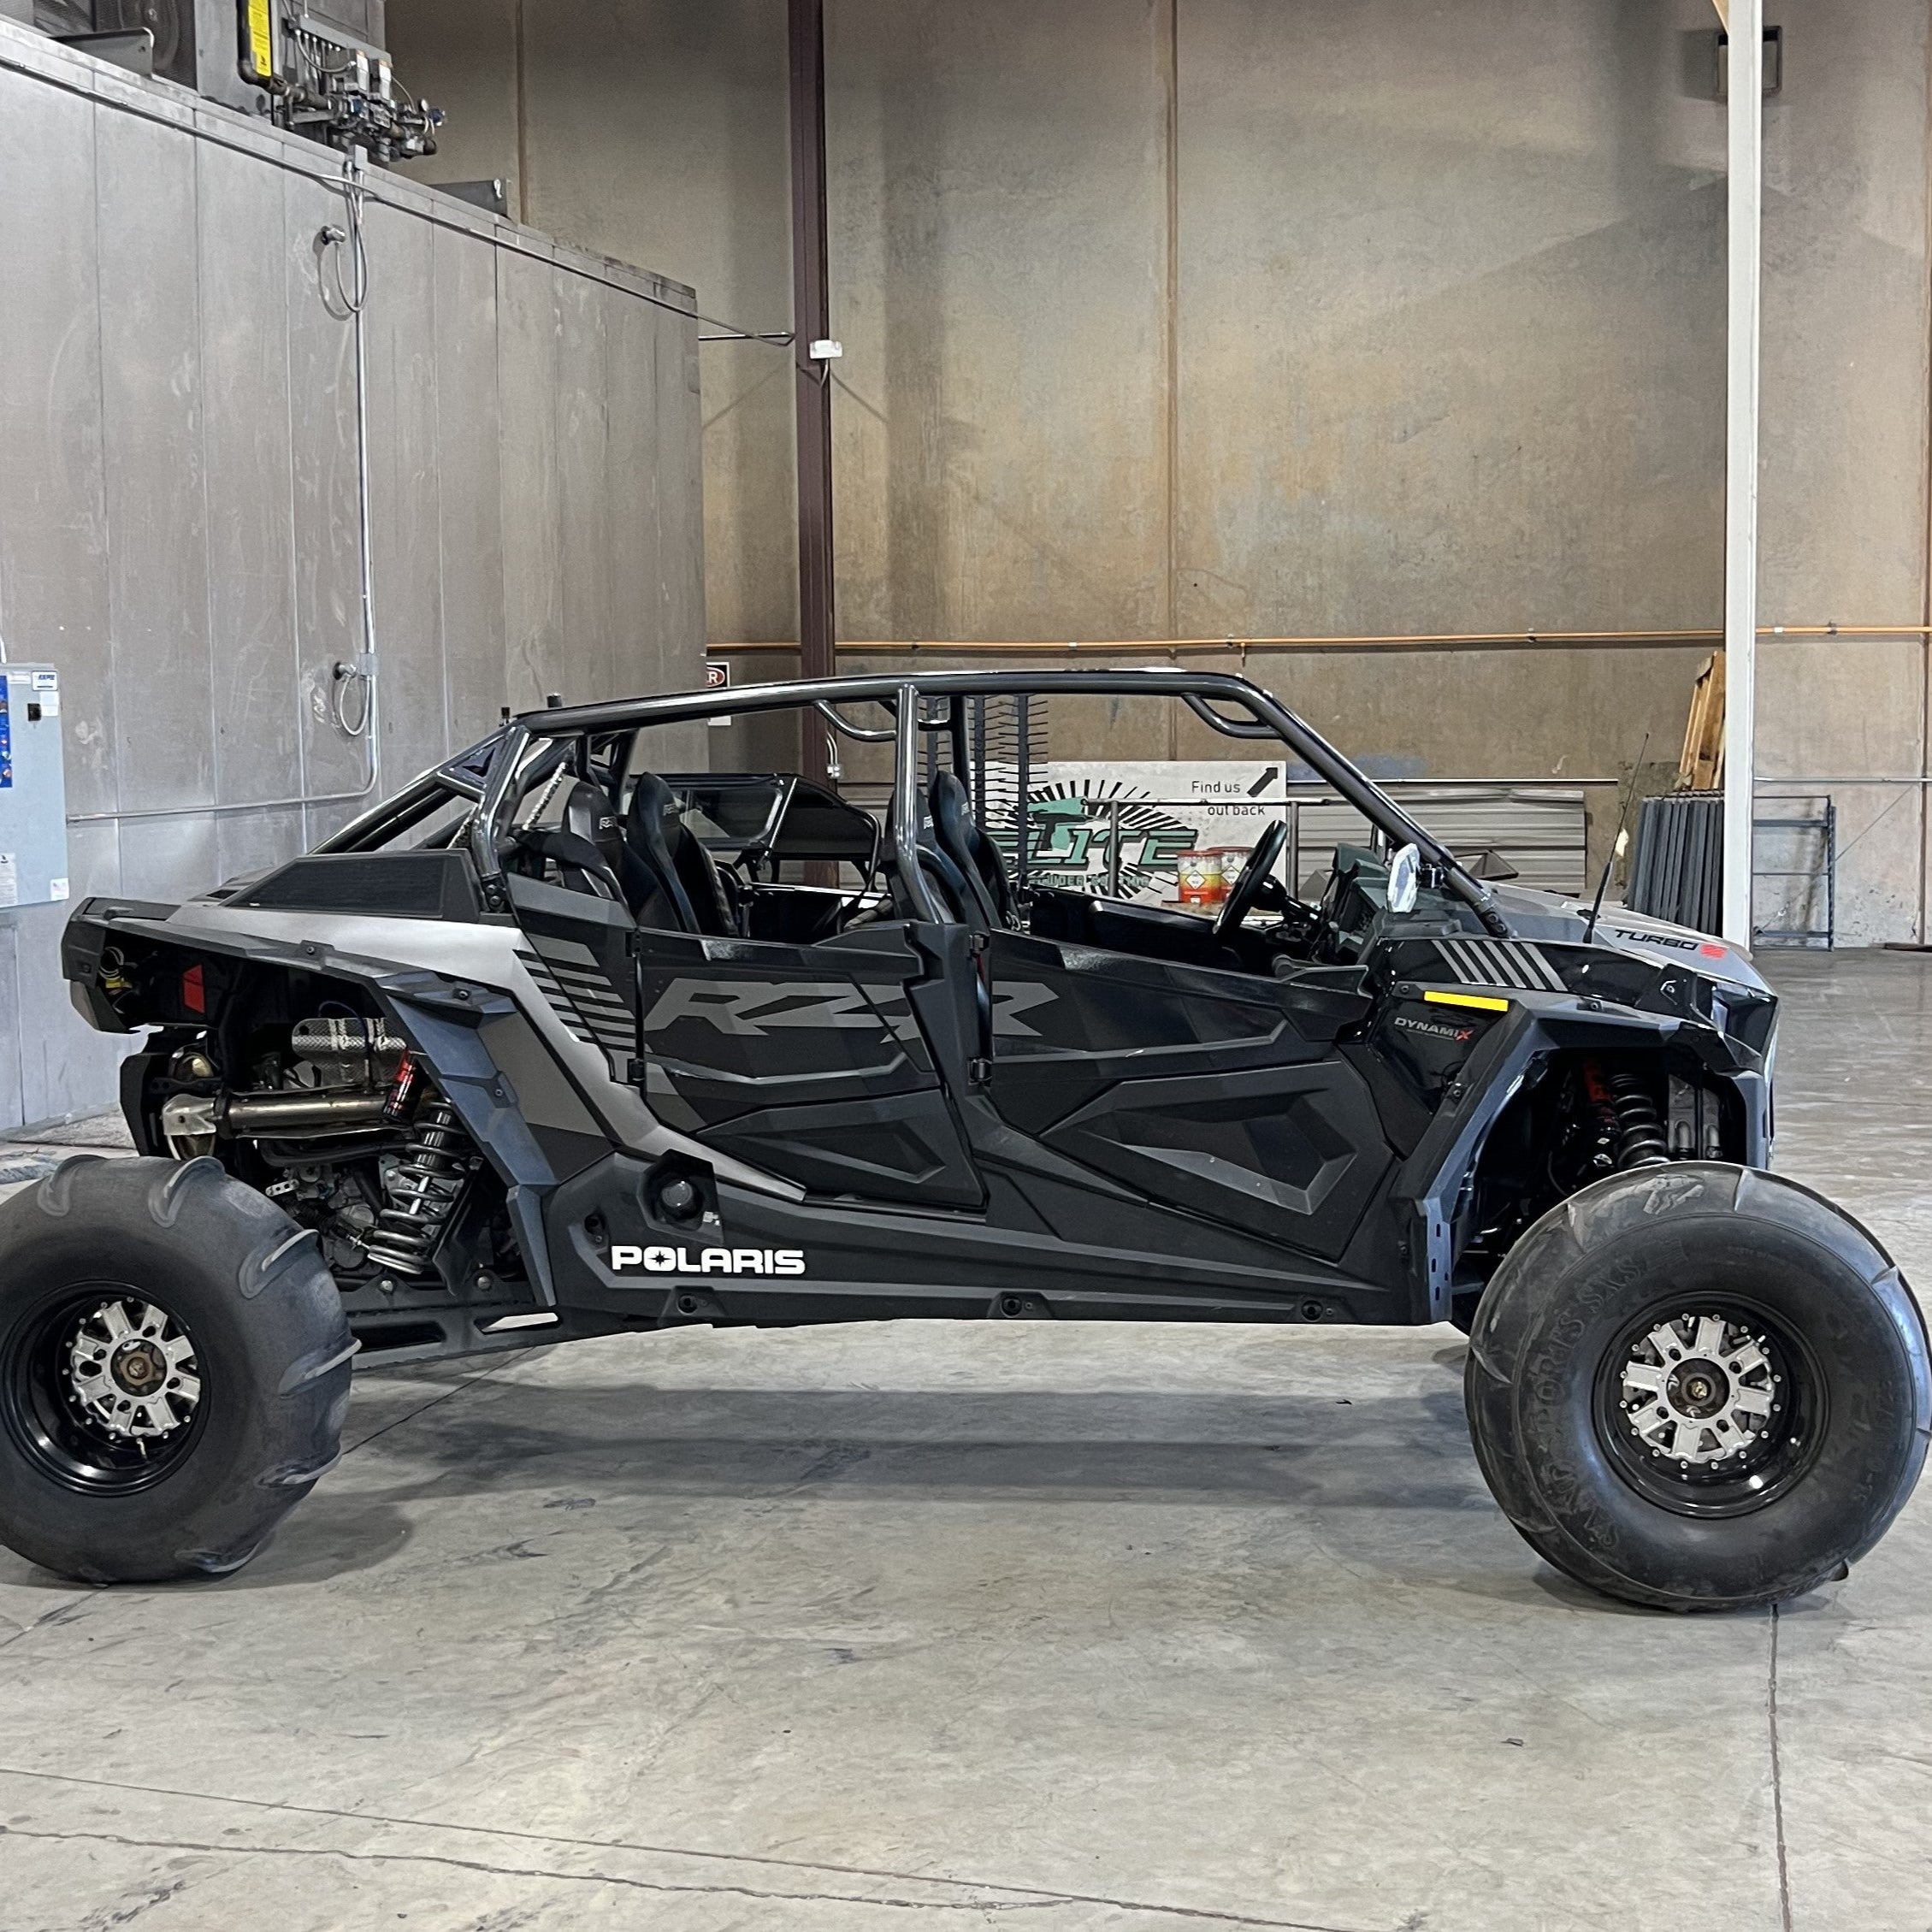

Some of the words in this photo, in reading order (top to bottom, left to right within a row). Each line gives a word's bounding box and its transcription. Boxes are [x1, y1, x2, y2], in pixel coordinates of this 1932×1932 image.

[1191, 780, 1220, 793] Find
[1225, 783, 1241, 793] us
[1232, 804, 1266, 815] back
[1615, 930, 1699, 951] TURBO
[1394, 1017, 1474, 1041] DYNAMIX
[611, 1245, 806, 1275] POLARIS
